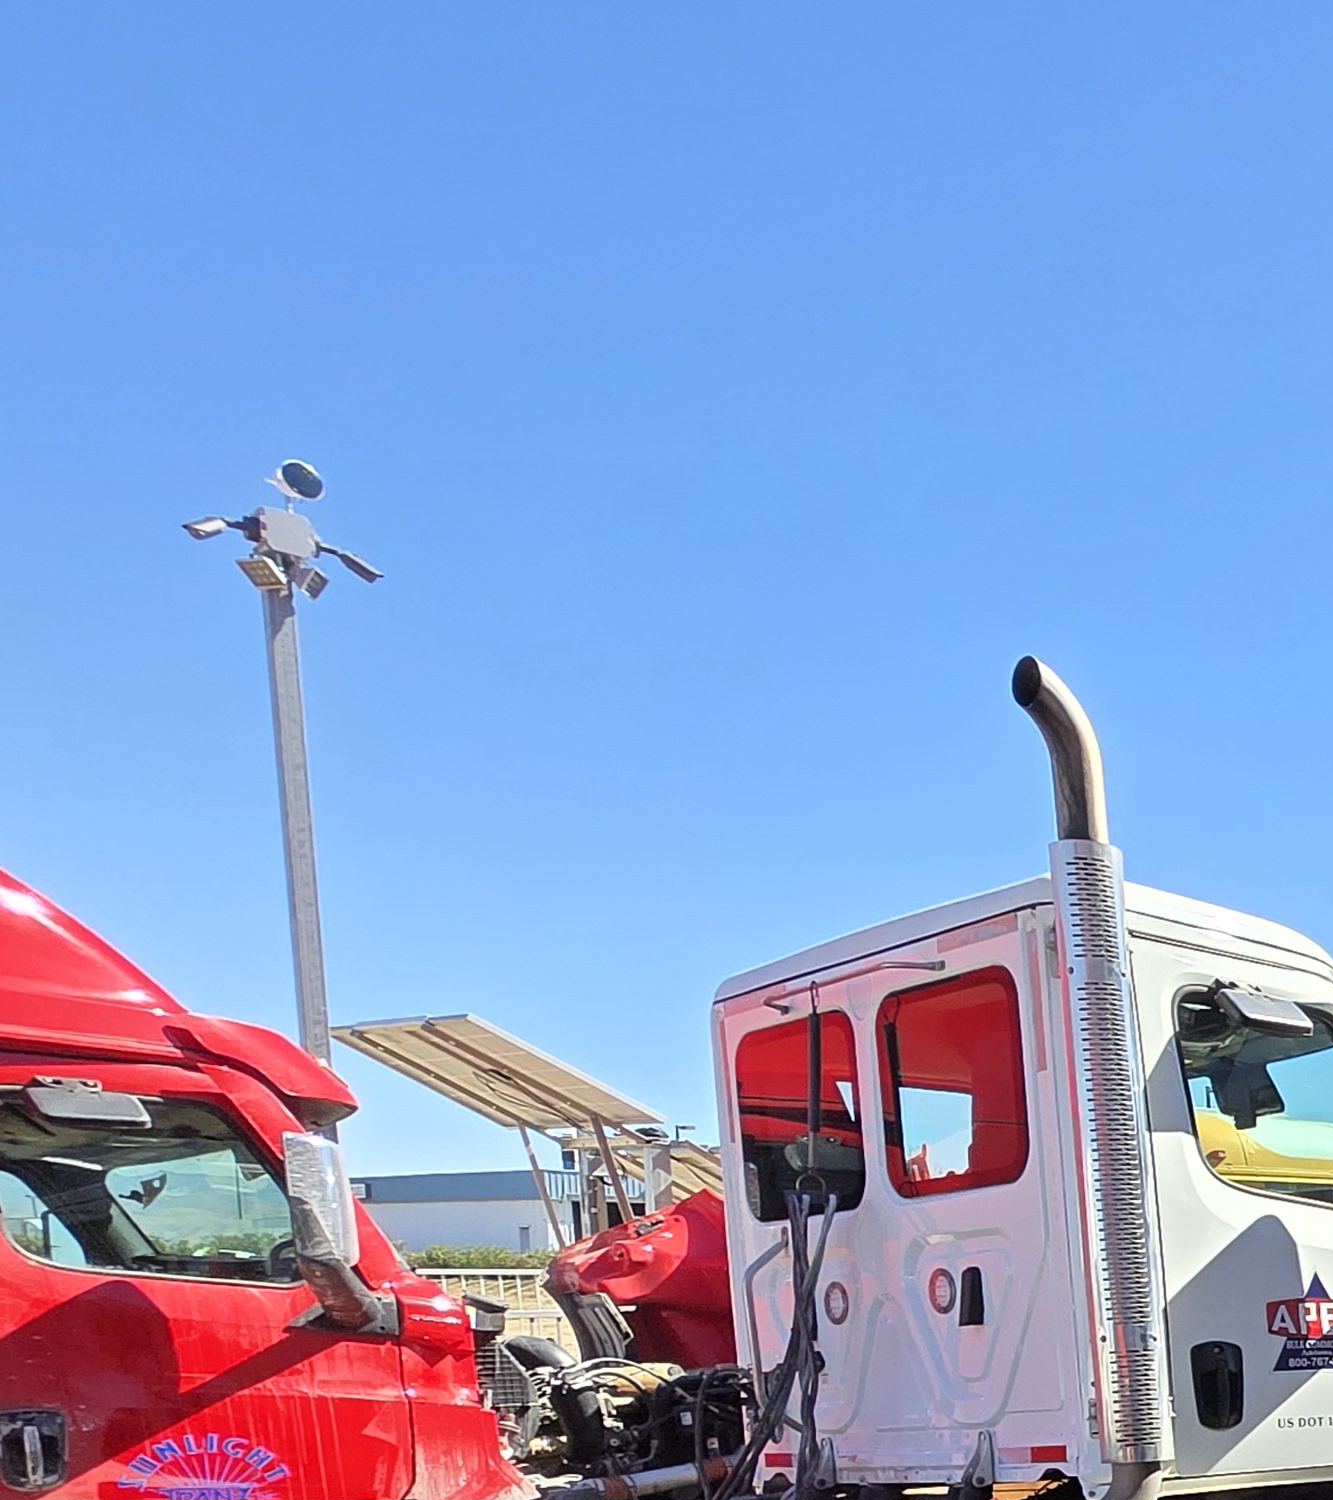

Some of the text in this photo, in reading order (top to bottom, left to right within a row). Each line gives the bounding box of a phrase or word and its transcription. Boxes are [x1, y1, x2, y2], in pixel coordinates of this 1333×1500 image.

[1277, 1418, 1294, 1429] US
[1298, 1416, 1325, 1428] DOT
[117, 1433, 292, 1492] SUNLIGHT
